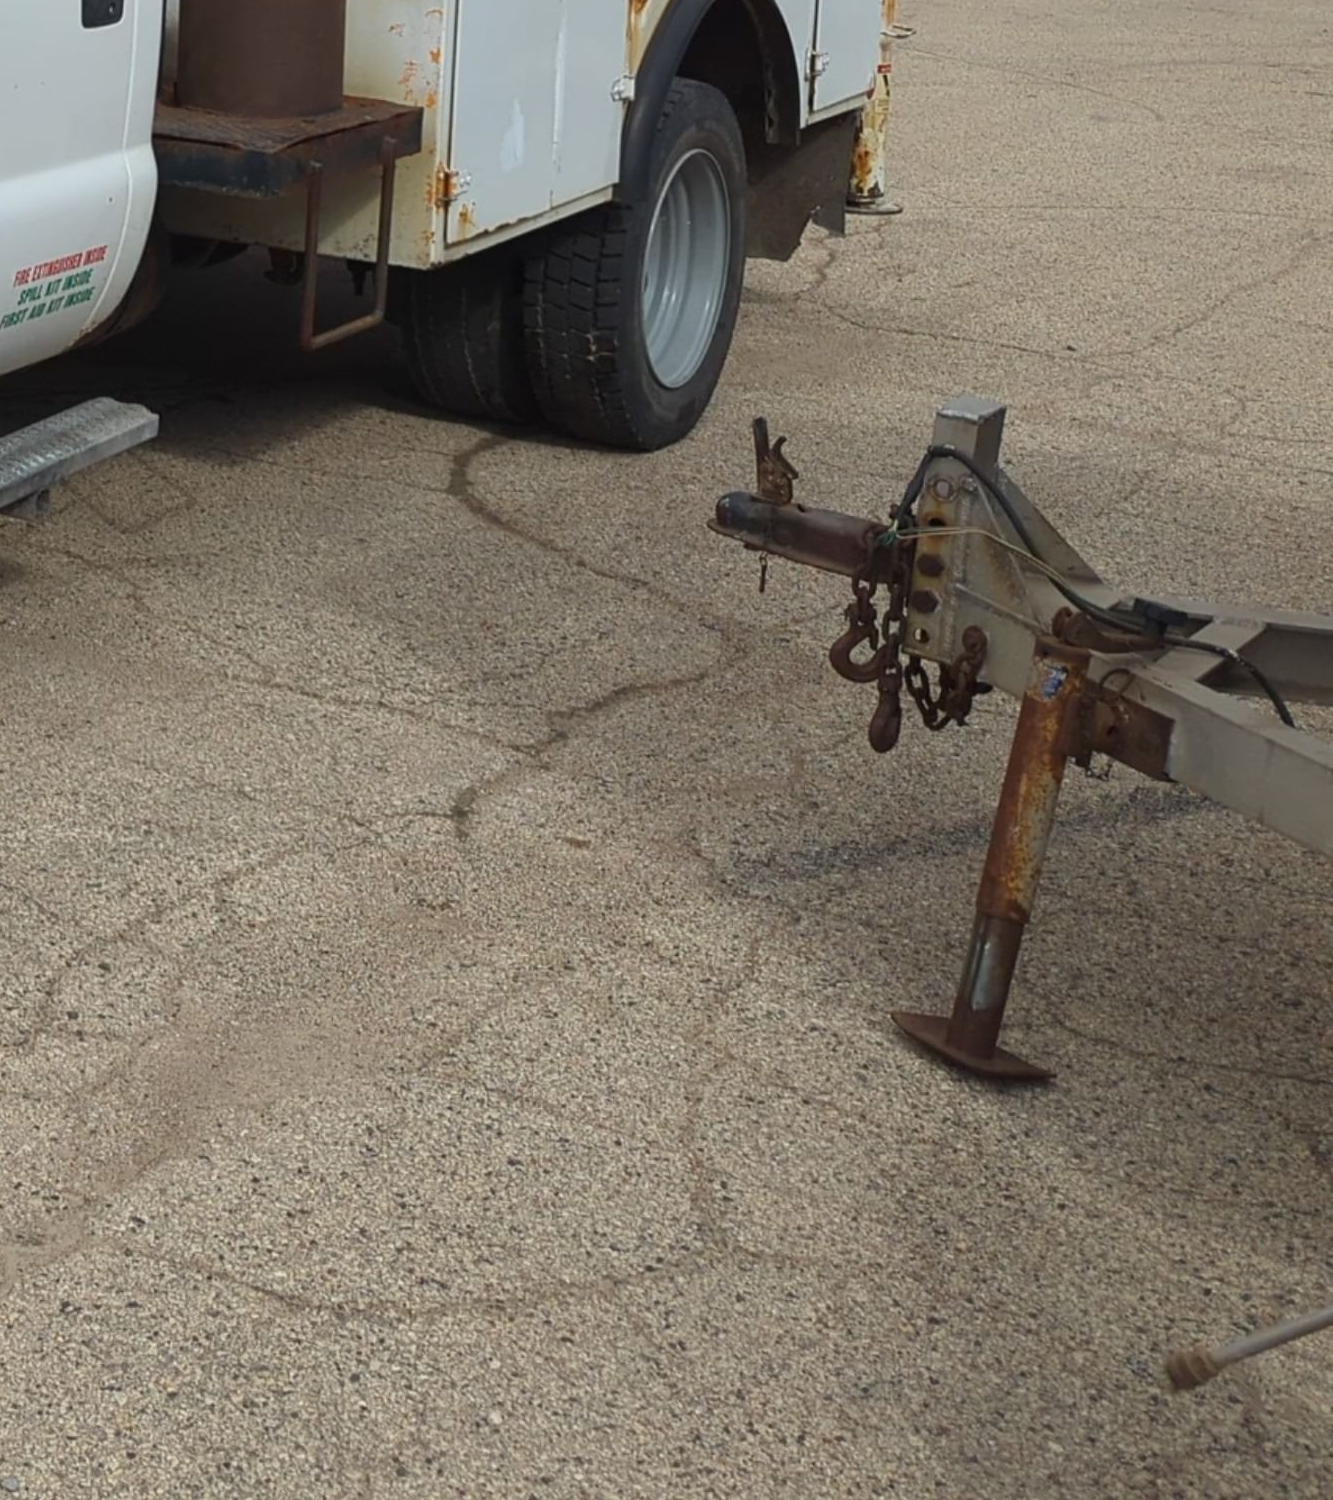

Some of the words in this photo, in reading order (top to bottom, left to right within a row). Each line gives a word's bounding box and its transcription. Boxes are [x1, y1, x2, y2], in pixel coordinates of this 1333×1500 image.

[13, 267, 33, 288] FIRE
[32, 252, 83, 282] EXTINGUISHER
[82, 245, 108, 266] INSIDE
[17, 284, 44, 306] SPILL
[44, 278, 63, 298] KIT
[62, 268, 94, 292] INSIDE
[27, 302, 47, 321] AID
[46, 296, 65, 315] KIT
[63, 286, 96, 309] INSIDE
